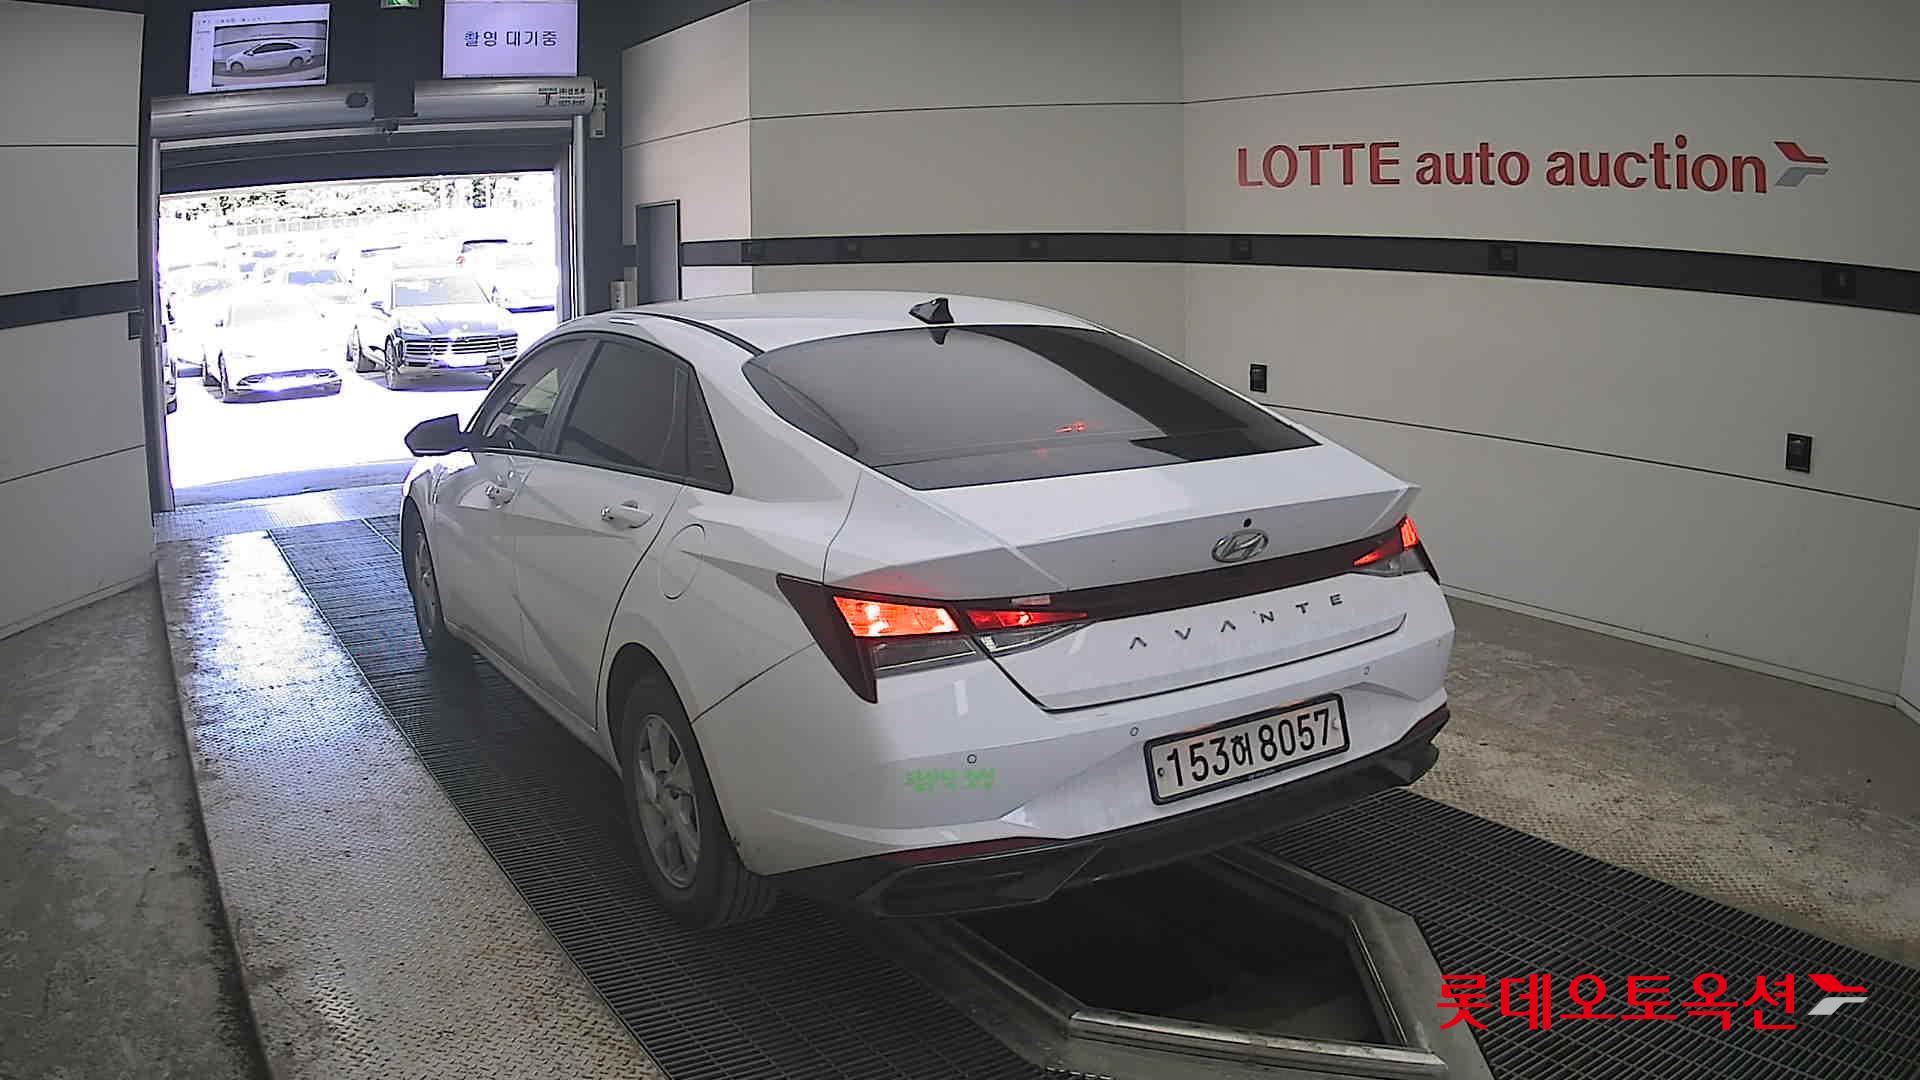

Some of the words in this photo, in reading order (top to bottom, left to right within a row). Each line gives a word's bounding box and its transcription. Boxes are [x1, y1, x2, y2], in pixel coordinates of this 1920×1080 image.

[506, 31, 558, 46] 대기중
[1237, 141, 1401, 188] LOTTE
[1415, 142, 1531, 187] auto
[1545, 134, 1768, 194] auction
[1128, 594, 1344, 650] AVANTE
